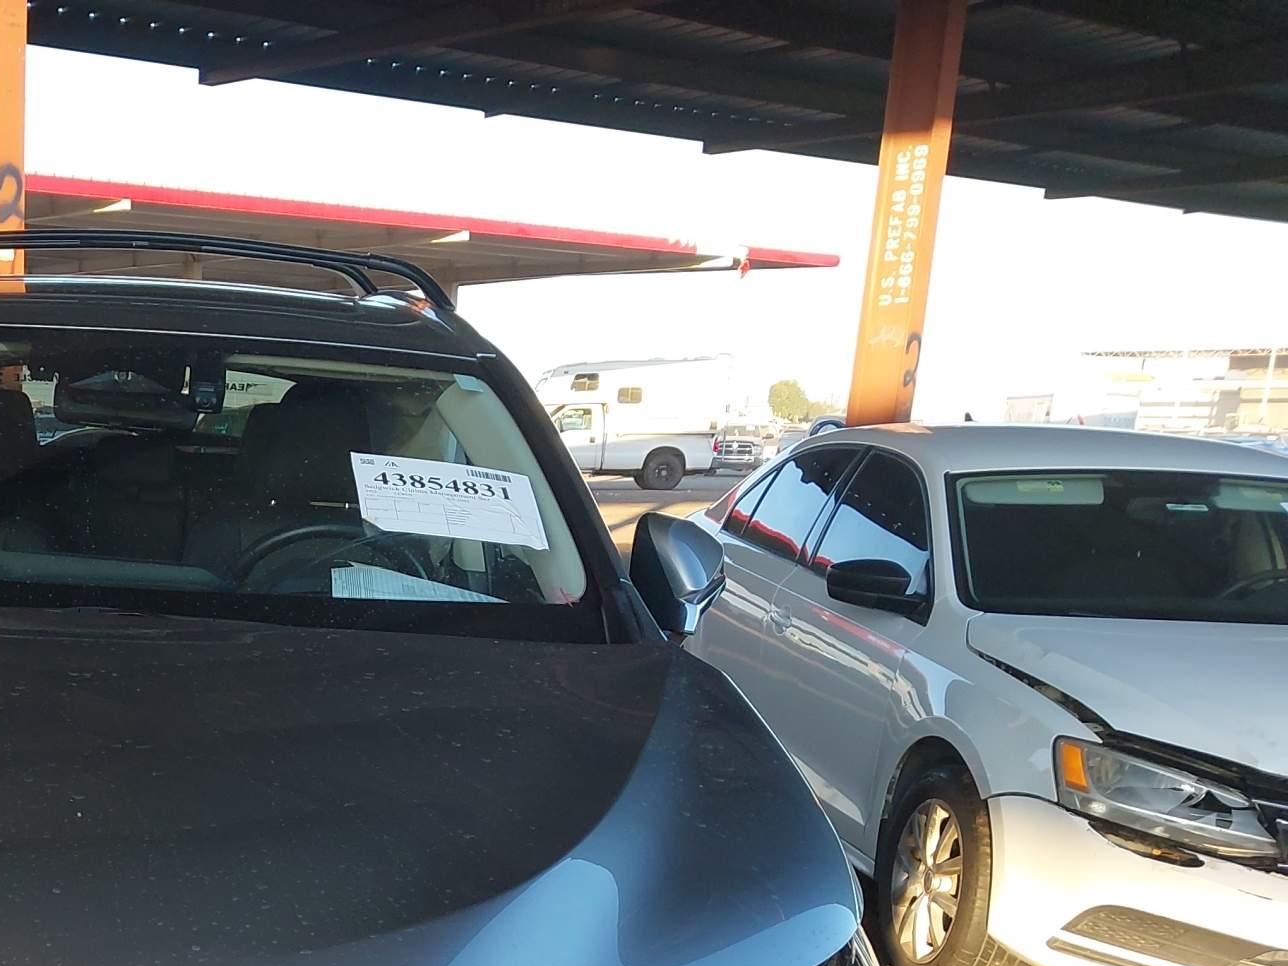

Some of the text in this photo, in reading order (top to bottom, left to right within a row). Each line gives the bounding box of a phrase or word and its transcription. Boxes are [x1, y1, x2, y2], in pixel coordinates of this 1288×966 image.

[884, 189, 907, 263] PREFAB
[880, 271, 897, 306] U.S.
[373, 470, 513, 502] 43854831
